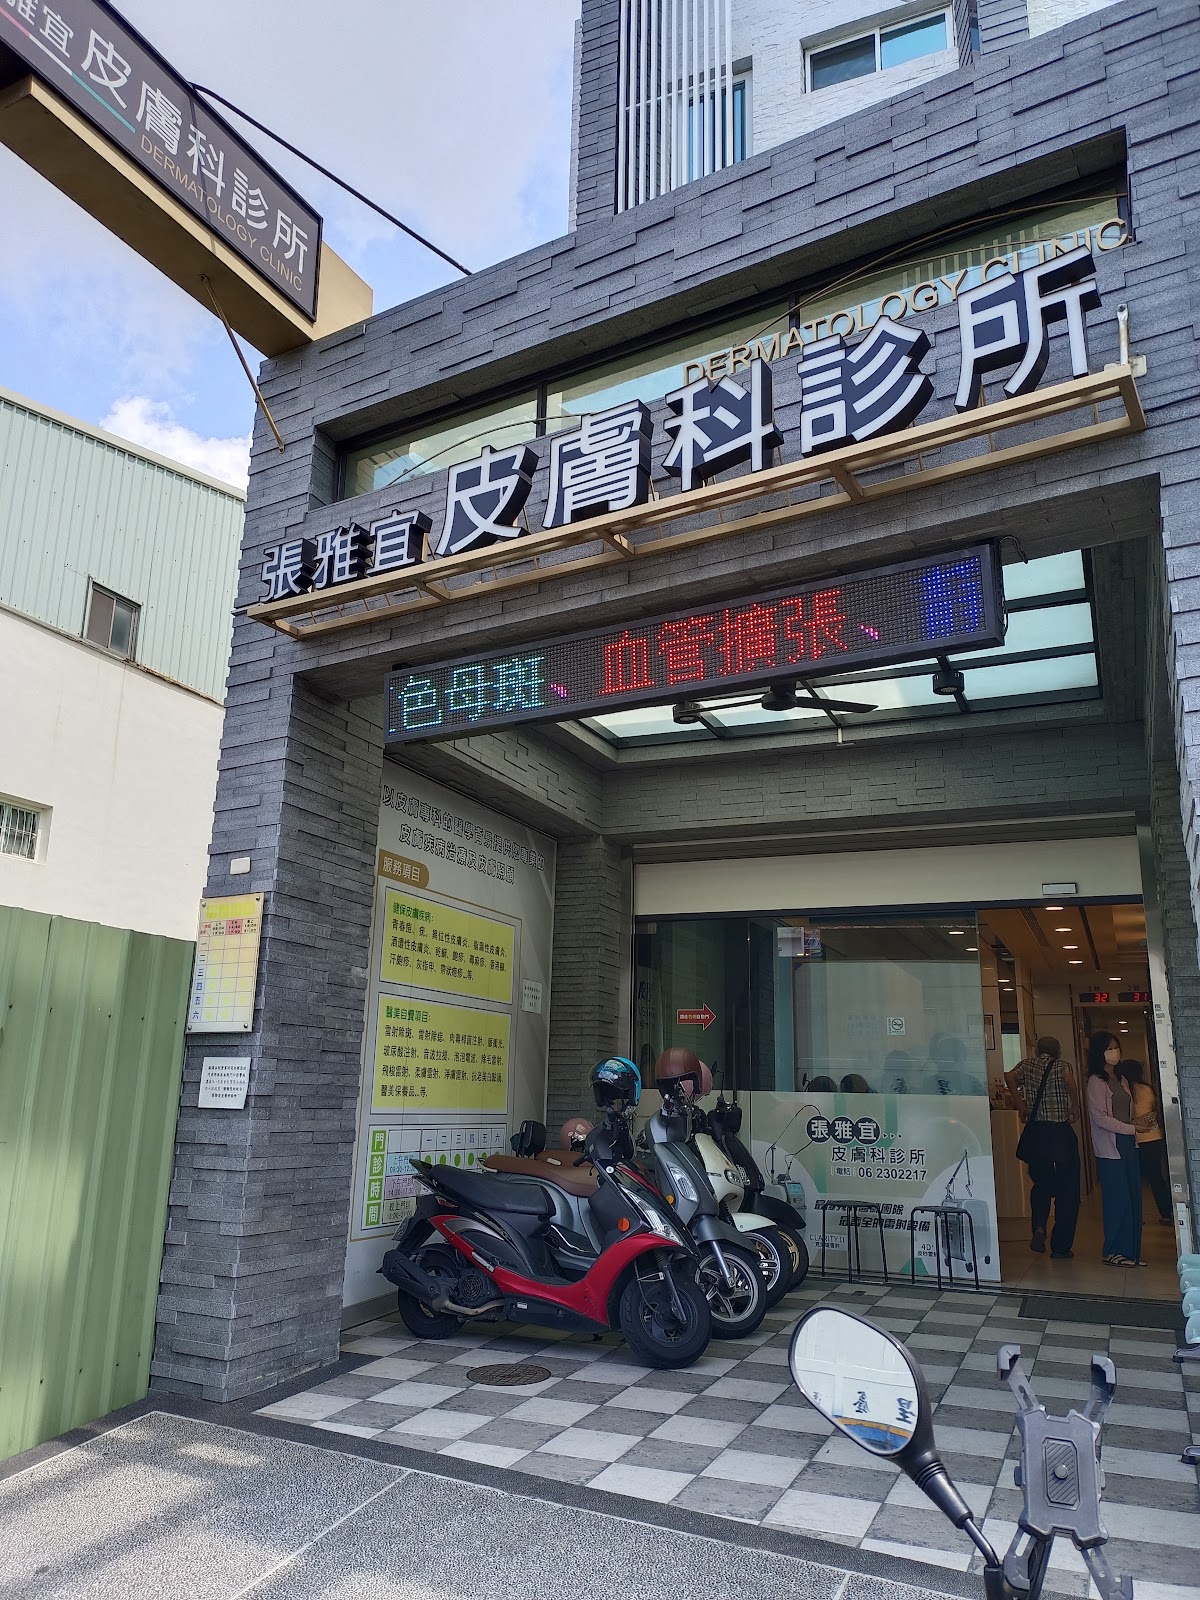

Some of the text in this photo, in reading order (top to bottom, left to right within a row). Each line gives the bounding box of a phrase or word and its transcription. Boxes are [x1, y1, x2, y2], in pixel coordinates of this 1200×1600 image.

[140, 134, 303, 292] DERMATOLOGY CLINIC
[683, 269, 969, 384] DERMATOLOGY
[260, 248, 1098, 600] 張雅宜皮膚科診所
[383, 856, 421, 883] 服務項目
[1094, 992, 1148, 1002] 32 31
[455, 1134, 462, 1145] 三
[494, 1132, 501, 1143] 六
[811, 1119, 877, 1141] 張雅宜
[831, 1146, 926, 1166] 皮膚科診所
[368, 1132, 385, 1224] 門診時間
[858, 1167, 873, 1178] 06
[876, 1168, 927, 1181] 2302217
